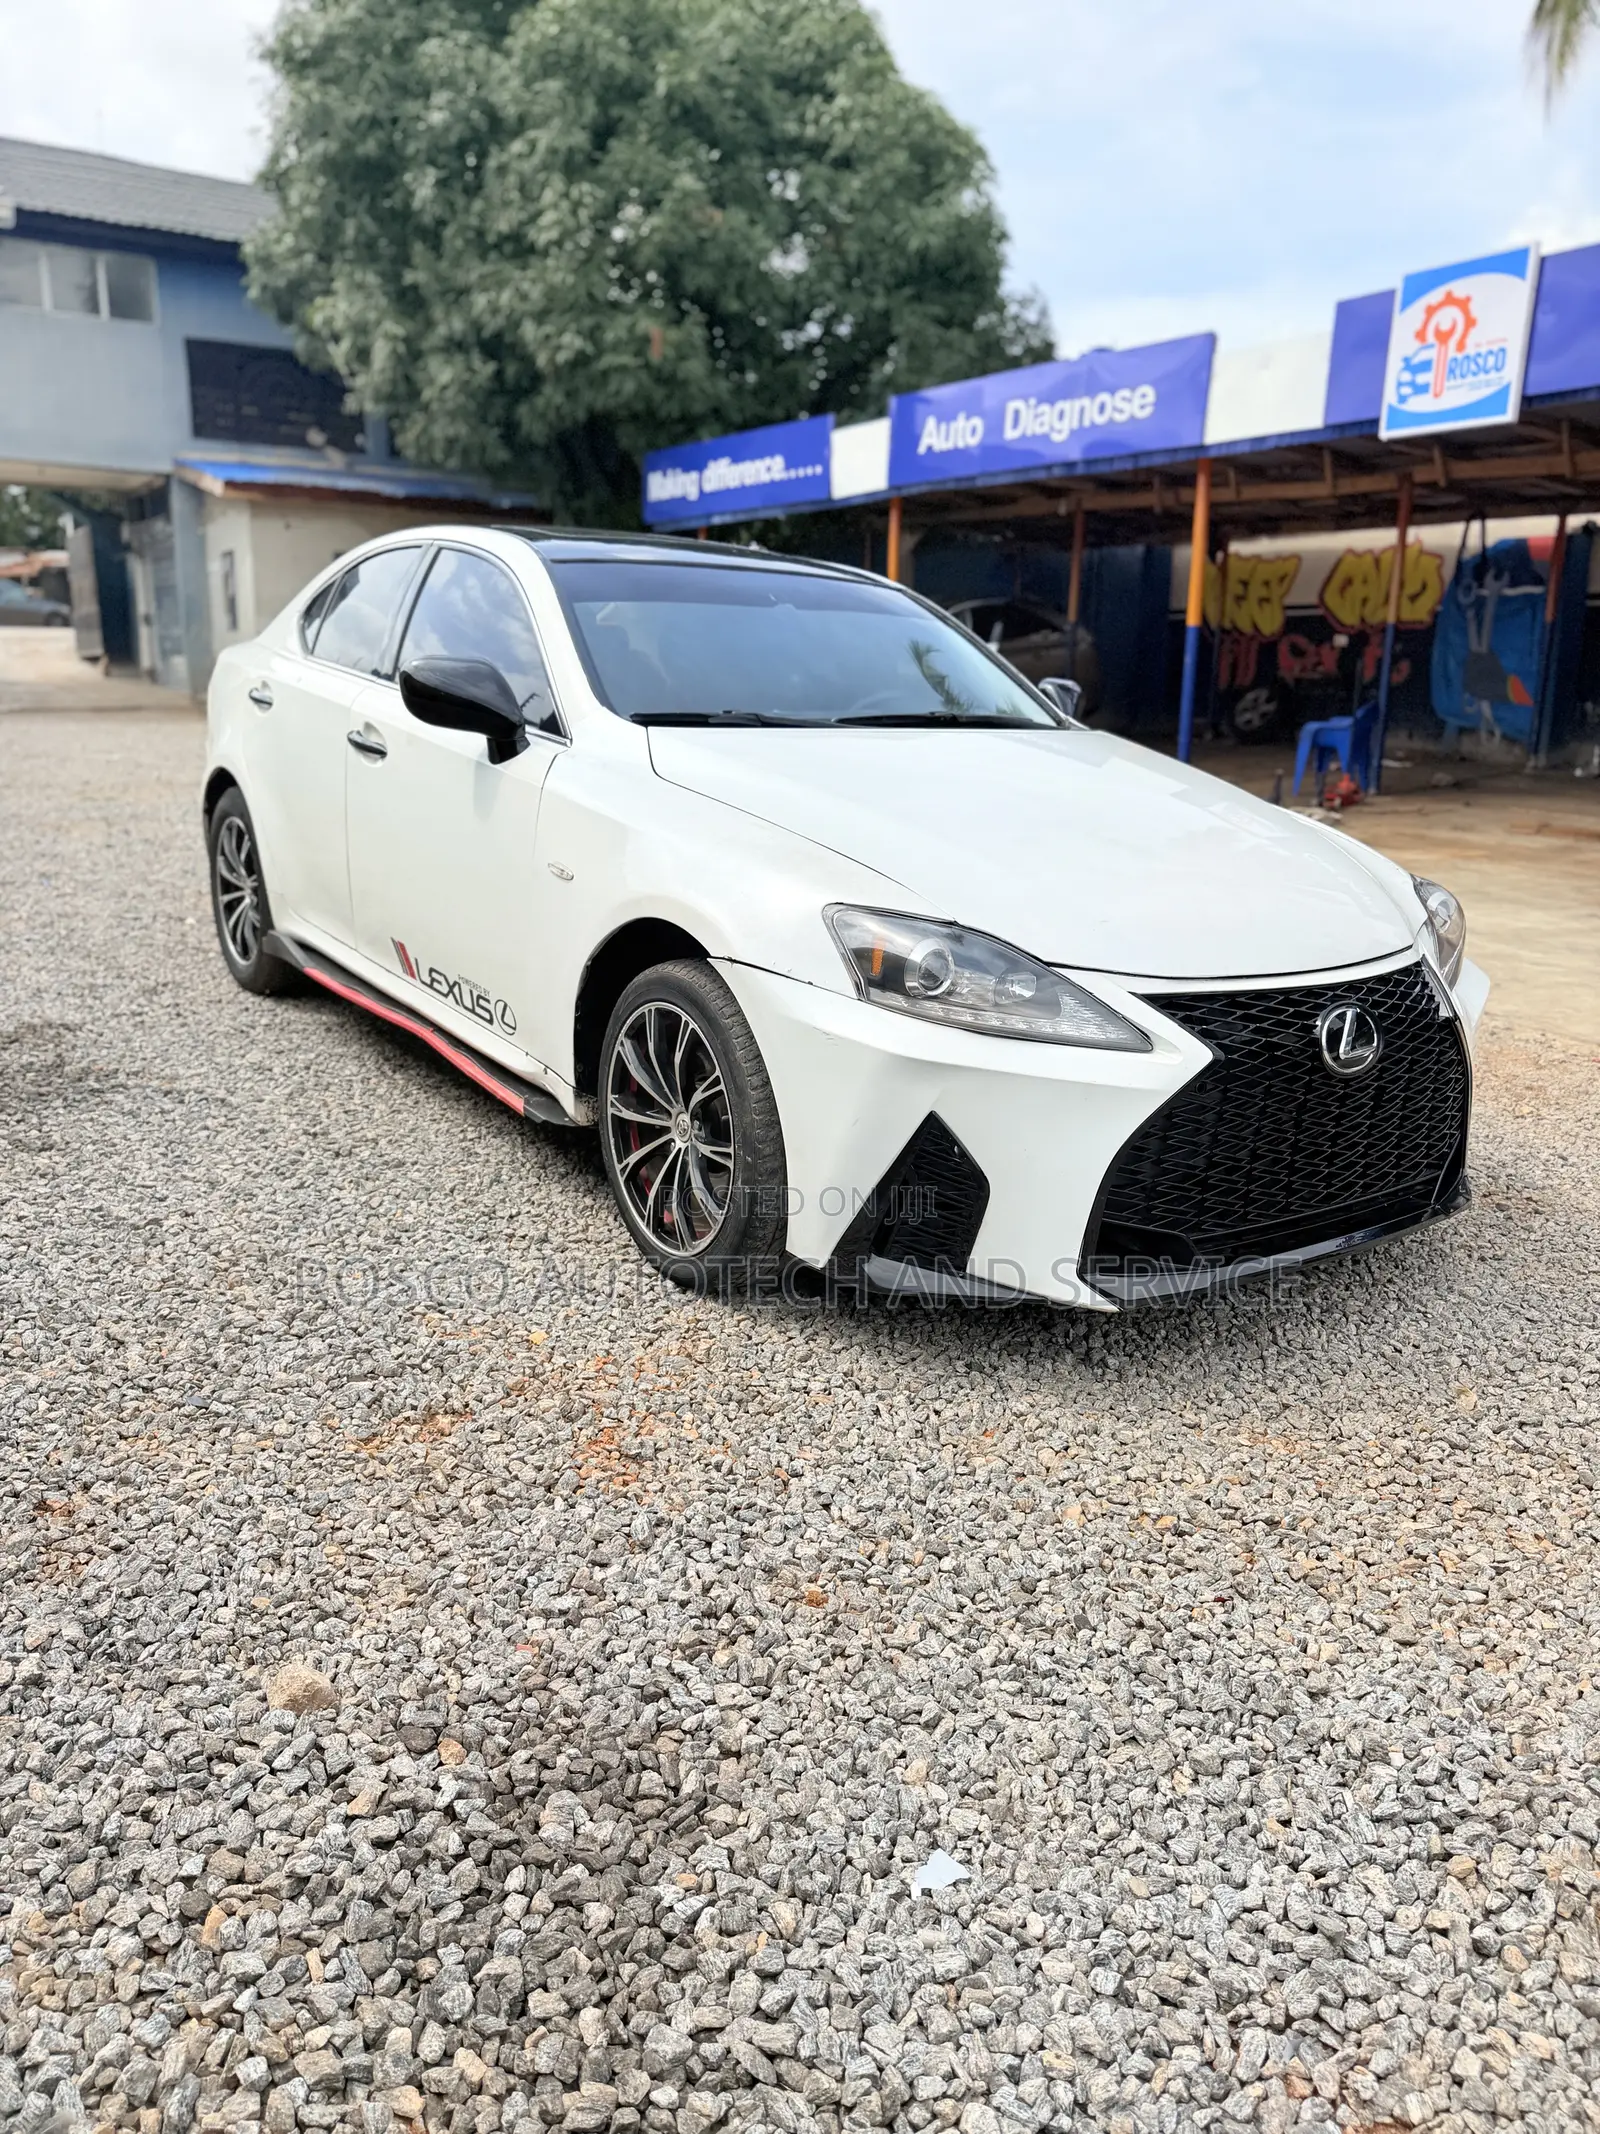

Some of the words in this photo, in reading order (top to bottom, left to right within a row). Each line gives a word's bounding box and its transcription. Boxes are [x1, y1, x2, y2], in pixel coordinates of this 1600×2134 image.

[1447, 347, 1507, 381] ROSCO
[917, 412, 984, 455] Auto
[1003, 384, 1157, 443] Diagnose
[414, 957, 494, 1025] LEXUS
